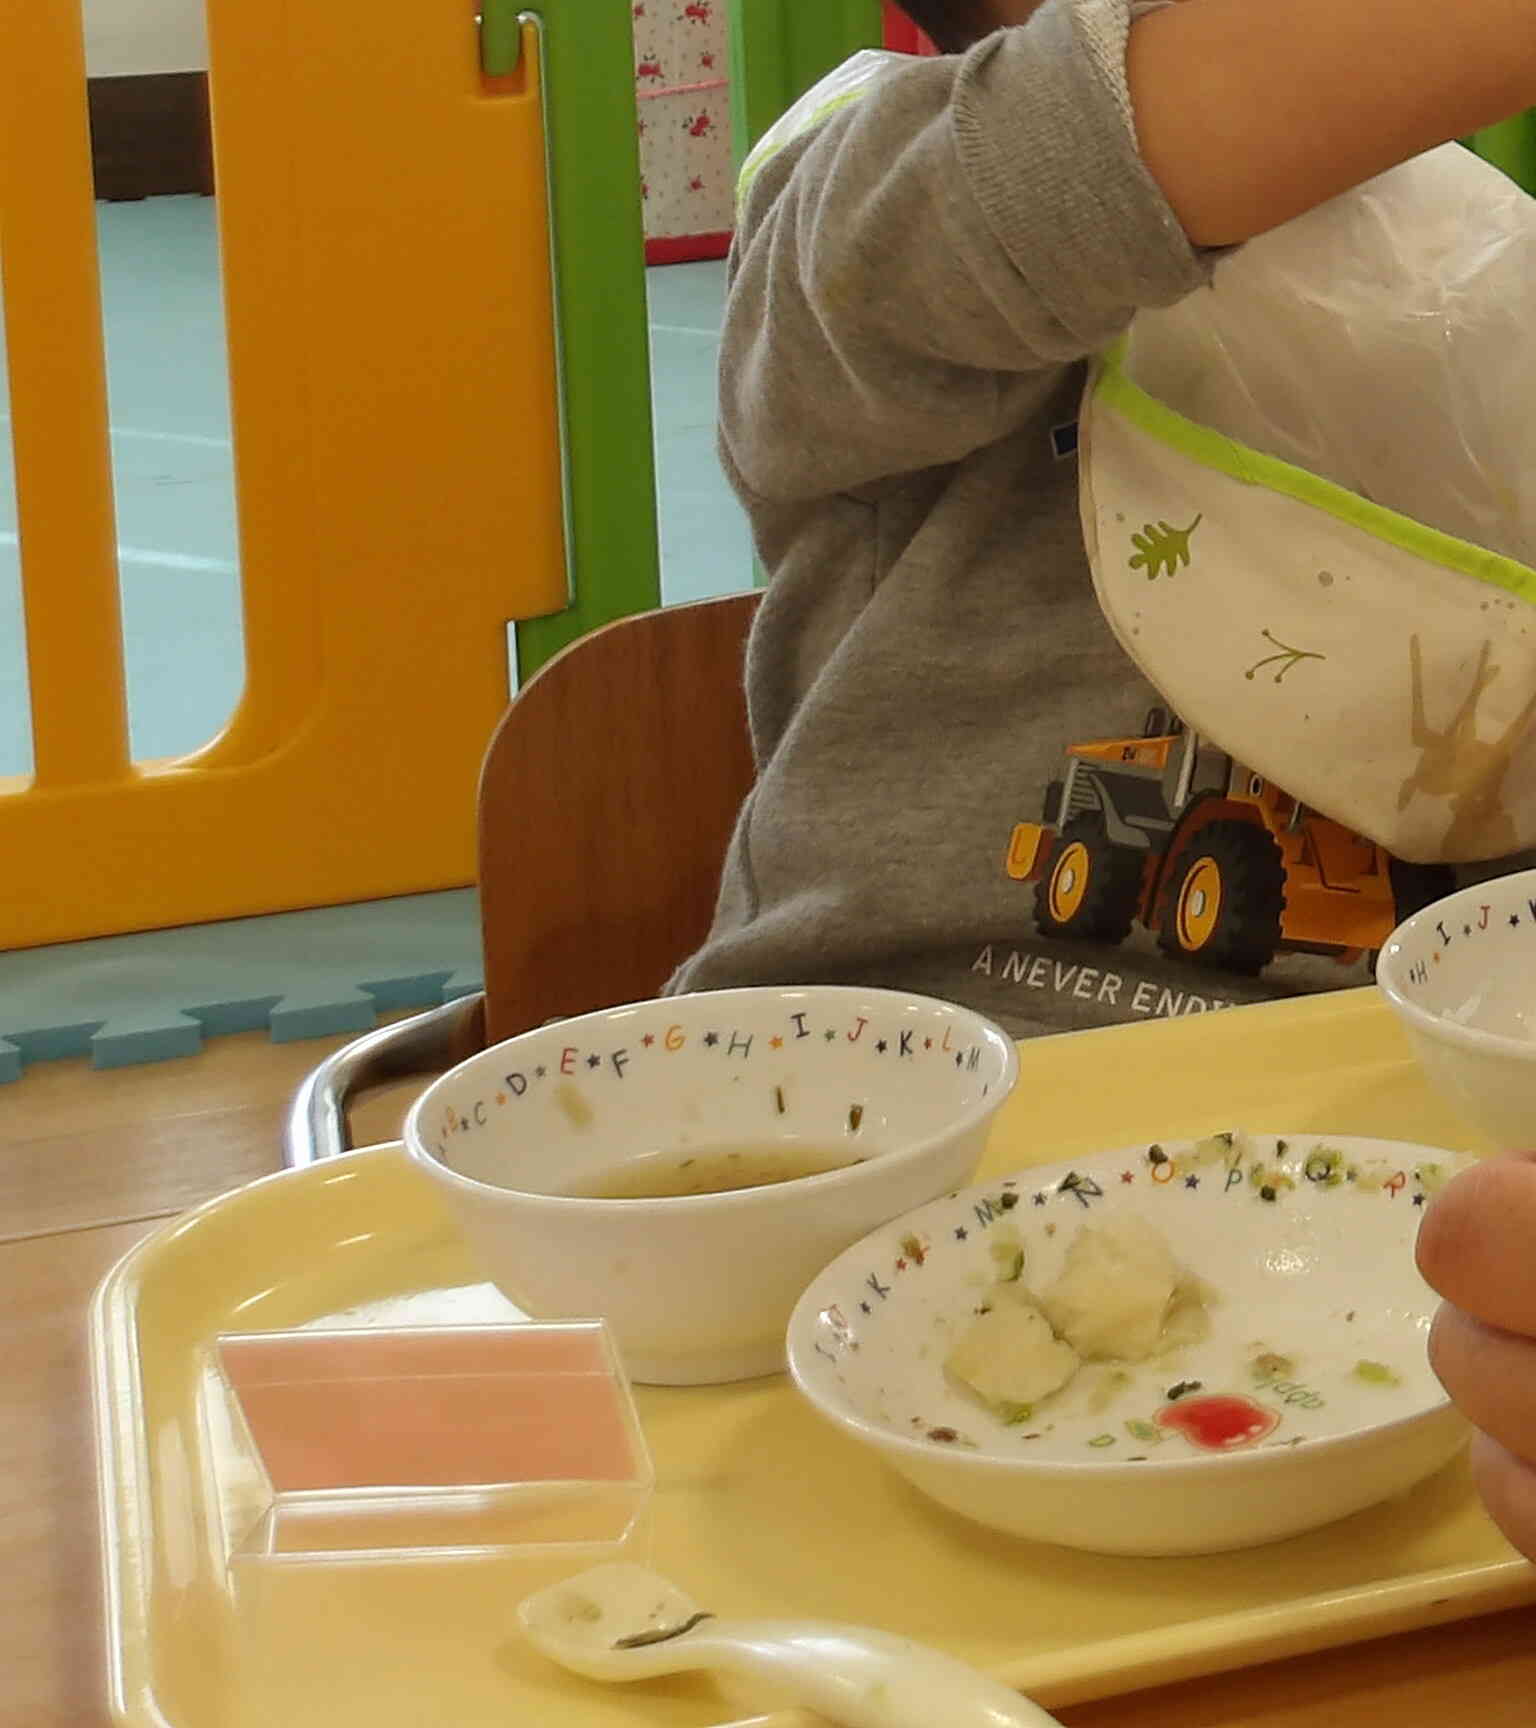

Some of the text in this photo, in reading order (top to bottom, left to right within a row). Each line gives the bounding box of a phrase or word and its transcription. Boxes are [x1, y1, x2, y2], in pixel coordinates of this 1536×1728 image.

[1478, 905, 1491, 930] J
[971, 943, 993, 976] A
[1001, 950, 1123, 1006] NEVER
[473, 1100, 488, 1126] C
[505, 1072, 528, 1096] D
[559, 1047, 579, 1076] E
[611, 1048, 630, 1079] F
[663, 1024, 687, 1052] G
[727, 1030, 754, 1059] H
[790, 1012, 810, 1038] I
[847, 1016, 869, 1042] J
[899, 1029, 913, 1056] K
[941, 1025, 955, 1052] L
[866, 1272, 891, 1300] K
